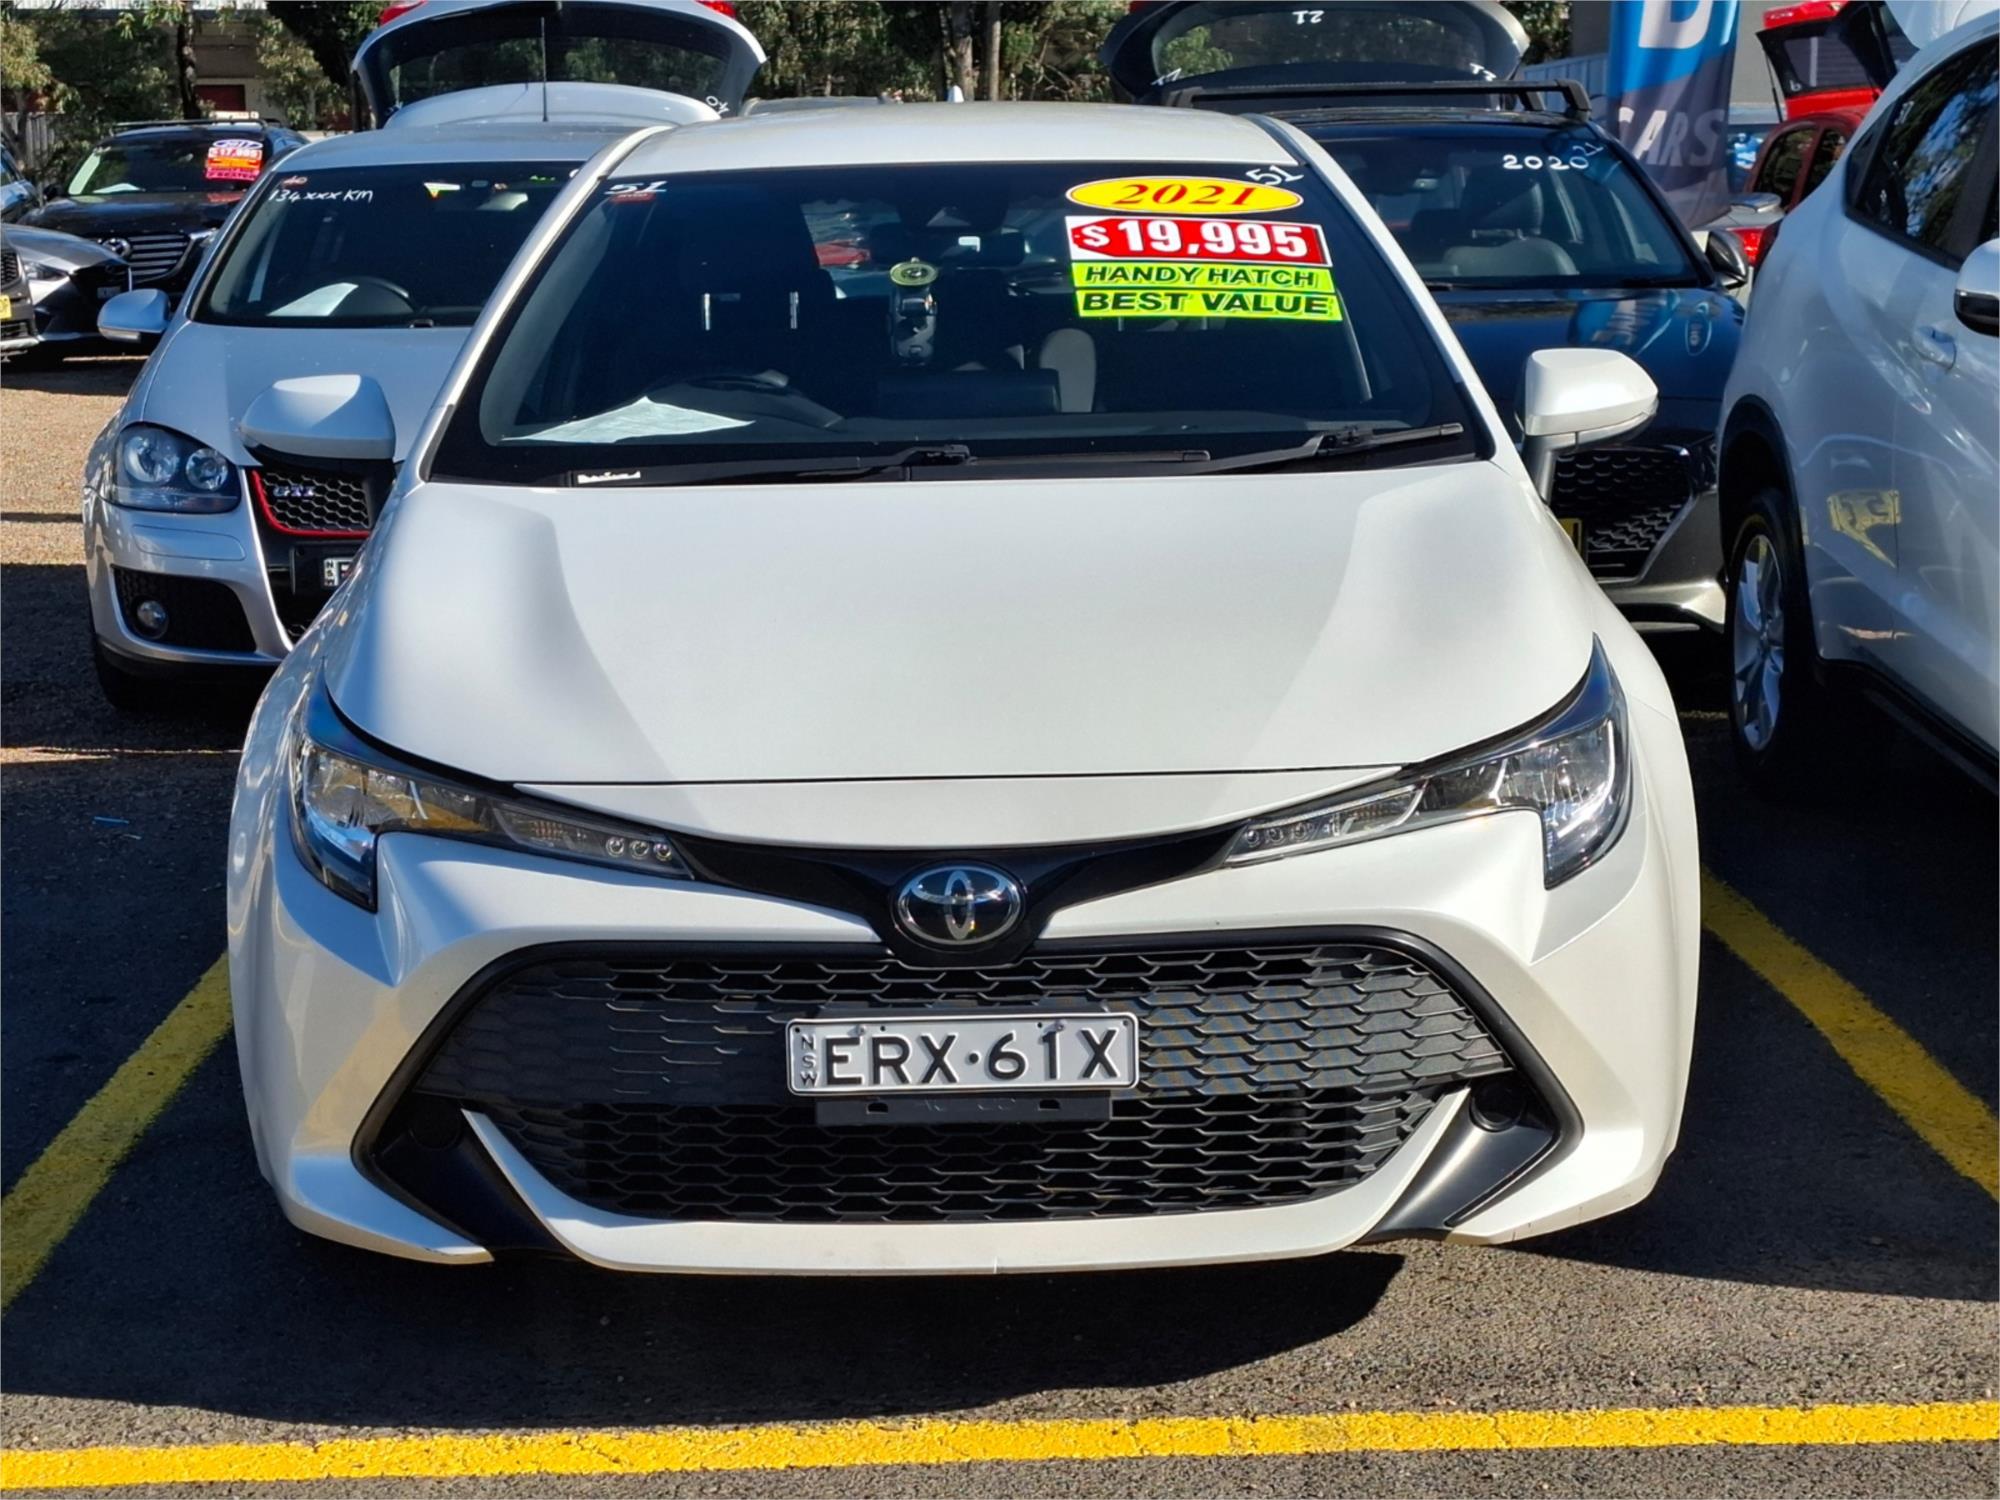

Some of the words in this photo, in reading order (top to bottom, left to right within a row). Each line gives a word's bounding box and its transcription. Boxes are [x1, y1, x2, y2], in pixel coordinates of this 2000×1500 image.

[1618, 106, 1726, 167] CARS
[1503, 154, 1589, 170] 2020
[1245, 164, 1305, 186] 51
[1113, 184, 1258, 206] 2021
[1085, 265, 1201, 283] HANDY
[1207, 268, 1316, 286] HATCH
[1082, 292, 1190, 311] BEST
[1201, 294, 1329, 314] VALUE
[801, 1034, 819, 1087] NSW
